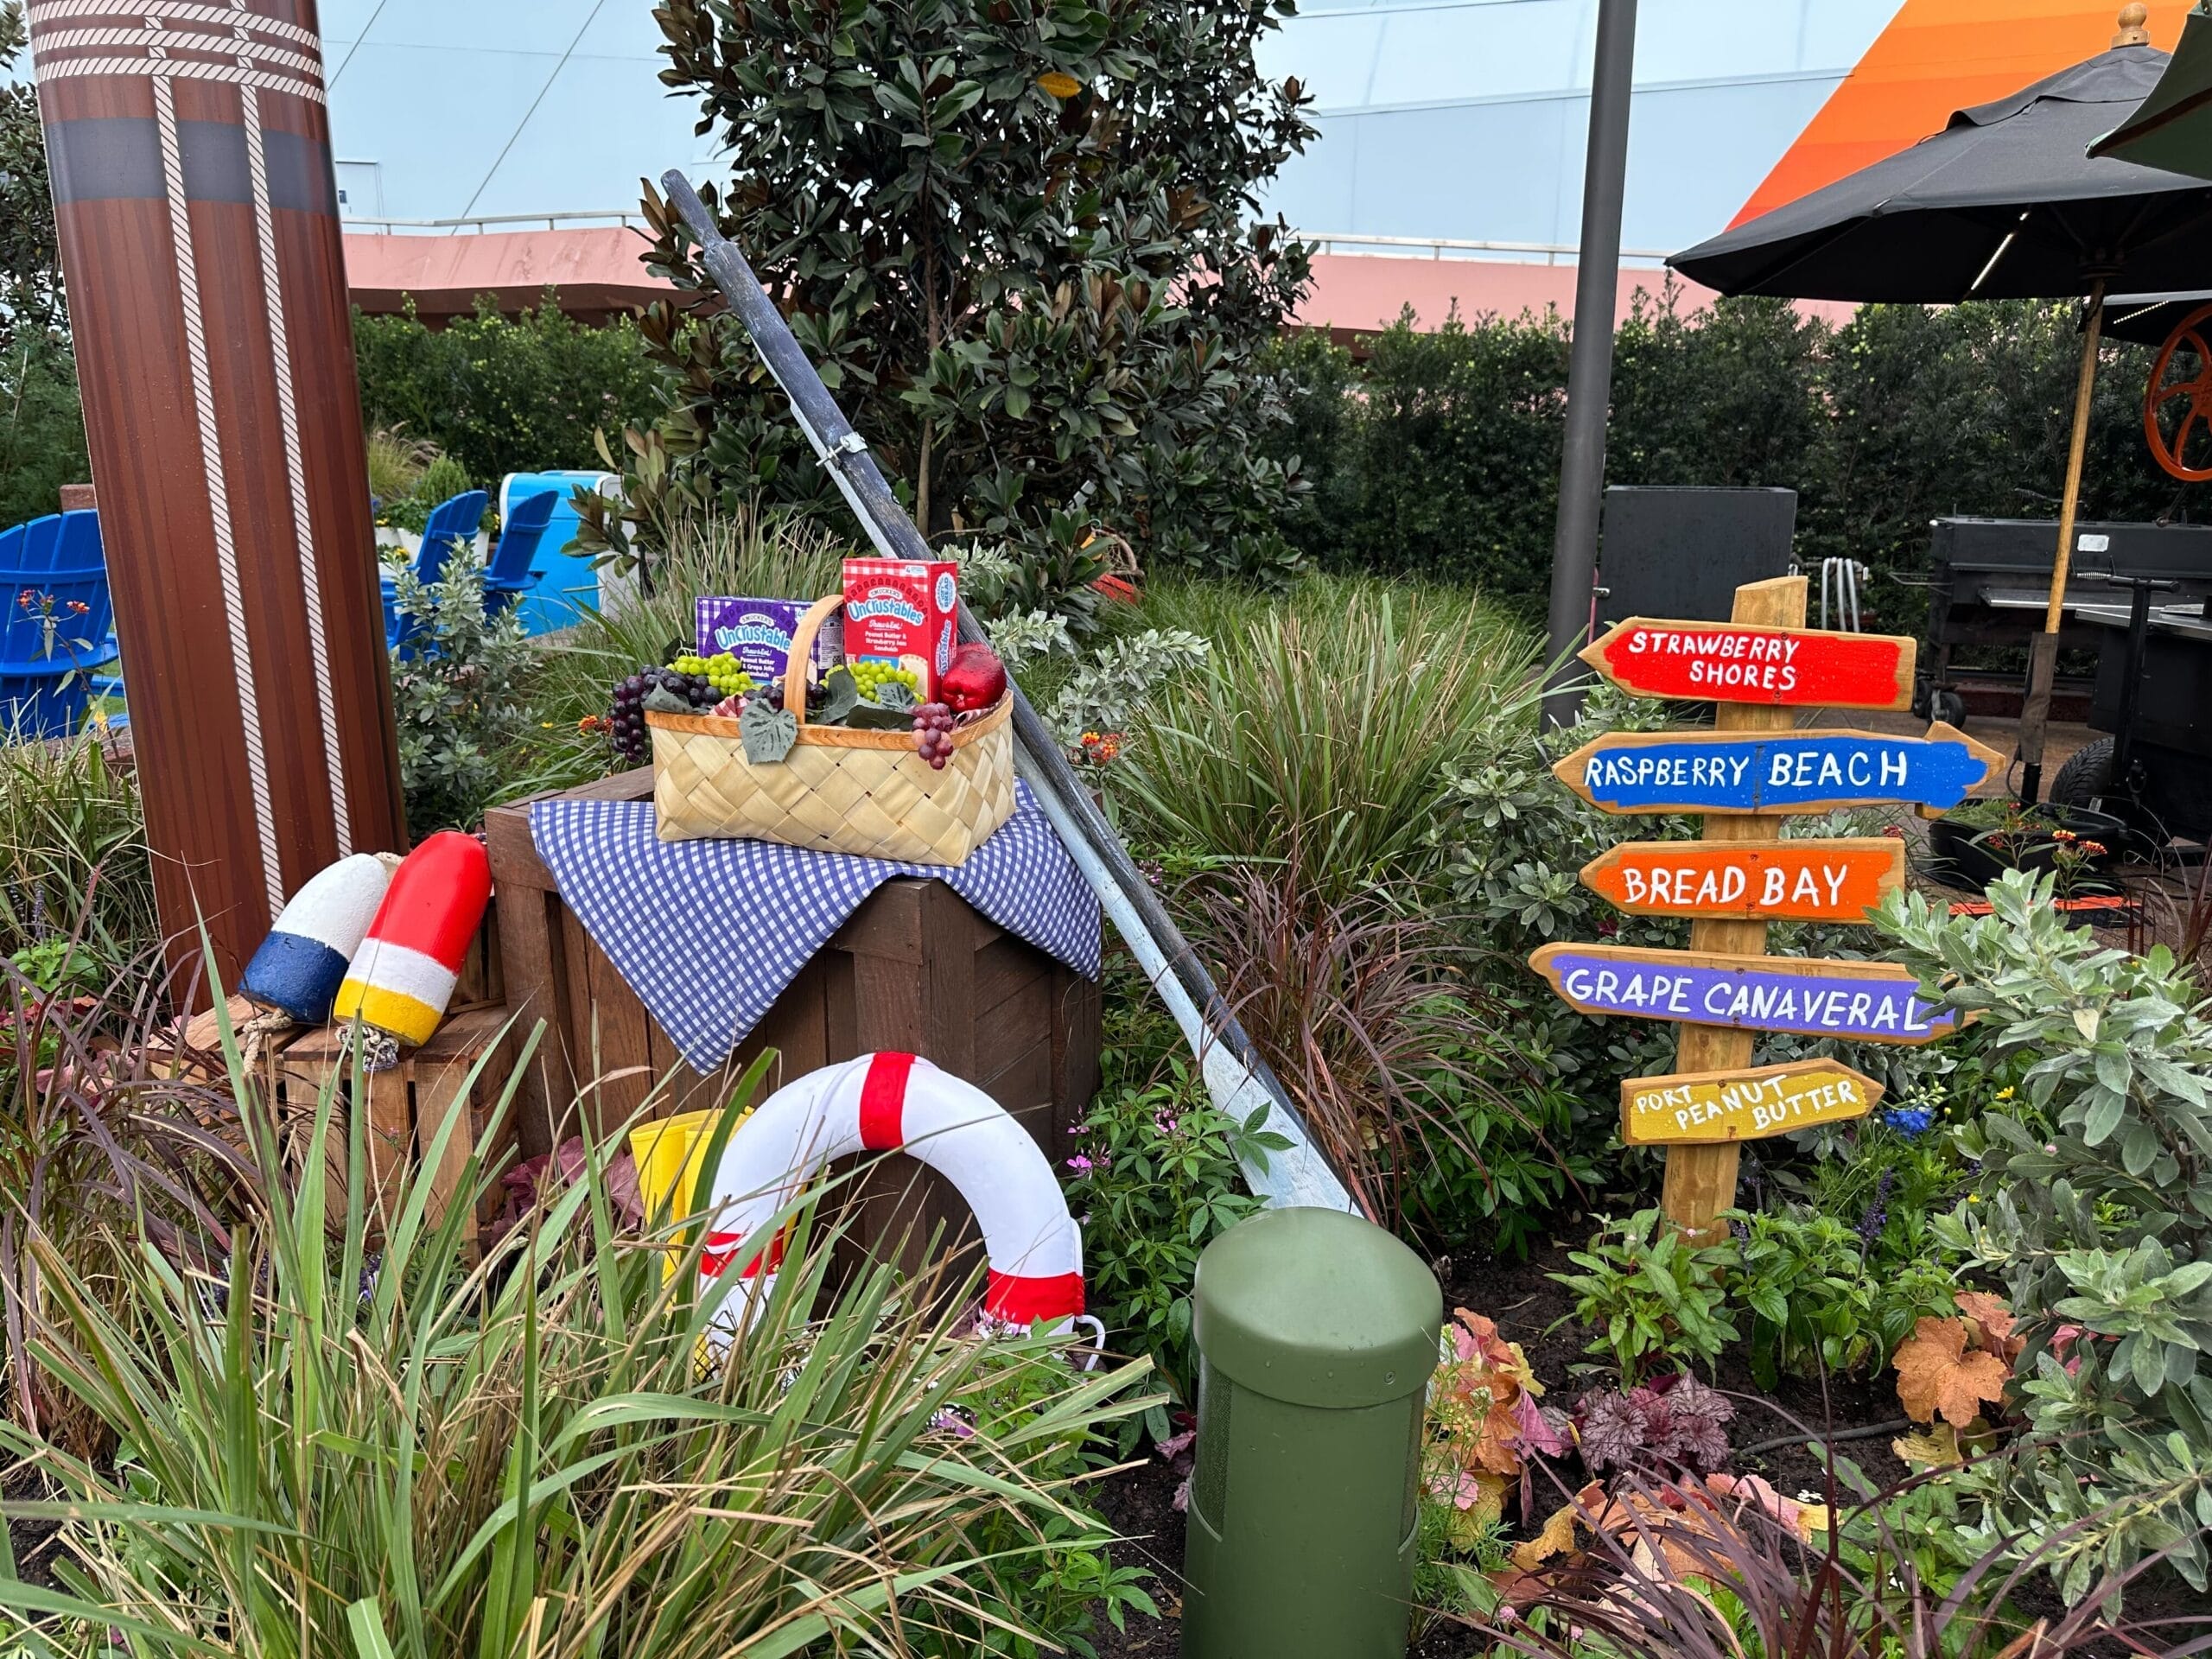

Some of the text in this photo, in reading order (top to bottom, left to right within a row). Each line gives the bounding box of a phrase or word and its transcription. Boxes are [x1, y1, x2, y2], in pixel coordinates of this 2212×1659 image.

[849, 599, 924, 625] Uncrustables
[715, 625, 791, 649] Uncrustable
[1629, 631, 1800, 664] STRAWBERRY
[1689, 660, 1796, 691] SHORES
[1584, 751, 1908, 787] RASPBERRY BEACH
[1623, 864, 1847, 907] BREAD BAY
[1566, 969, 1929, 1032] GRAPE CANAVERAL
[1636, 1084, 1693, 1115] PORT
[1675, 1074, 1789, 1130] PEANUT
[1752, 1080, 1858, 1131] BUTTER
